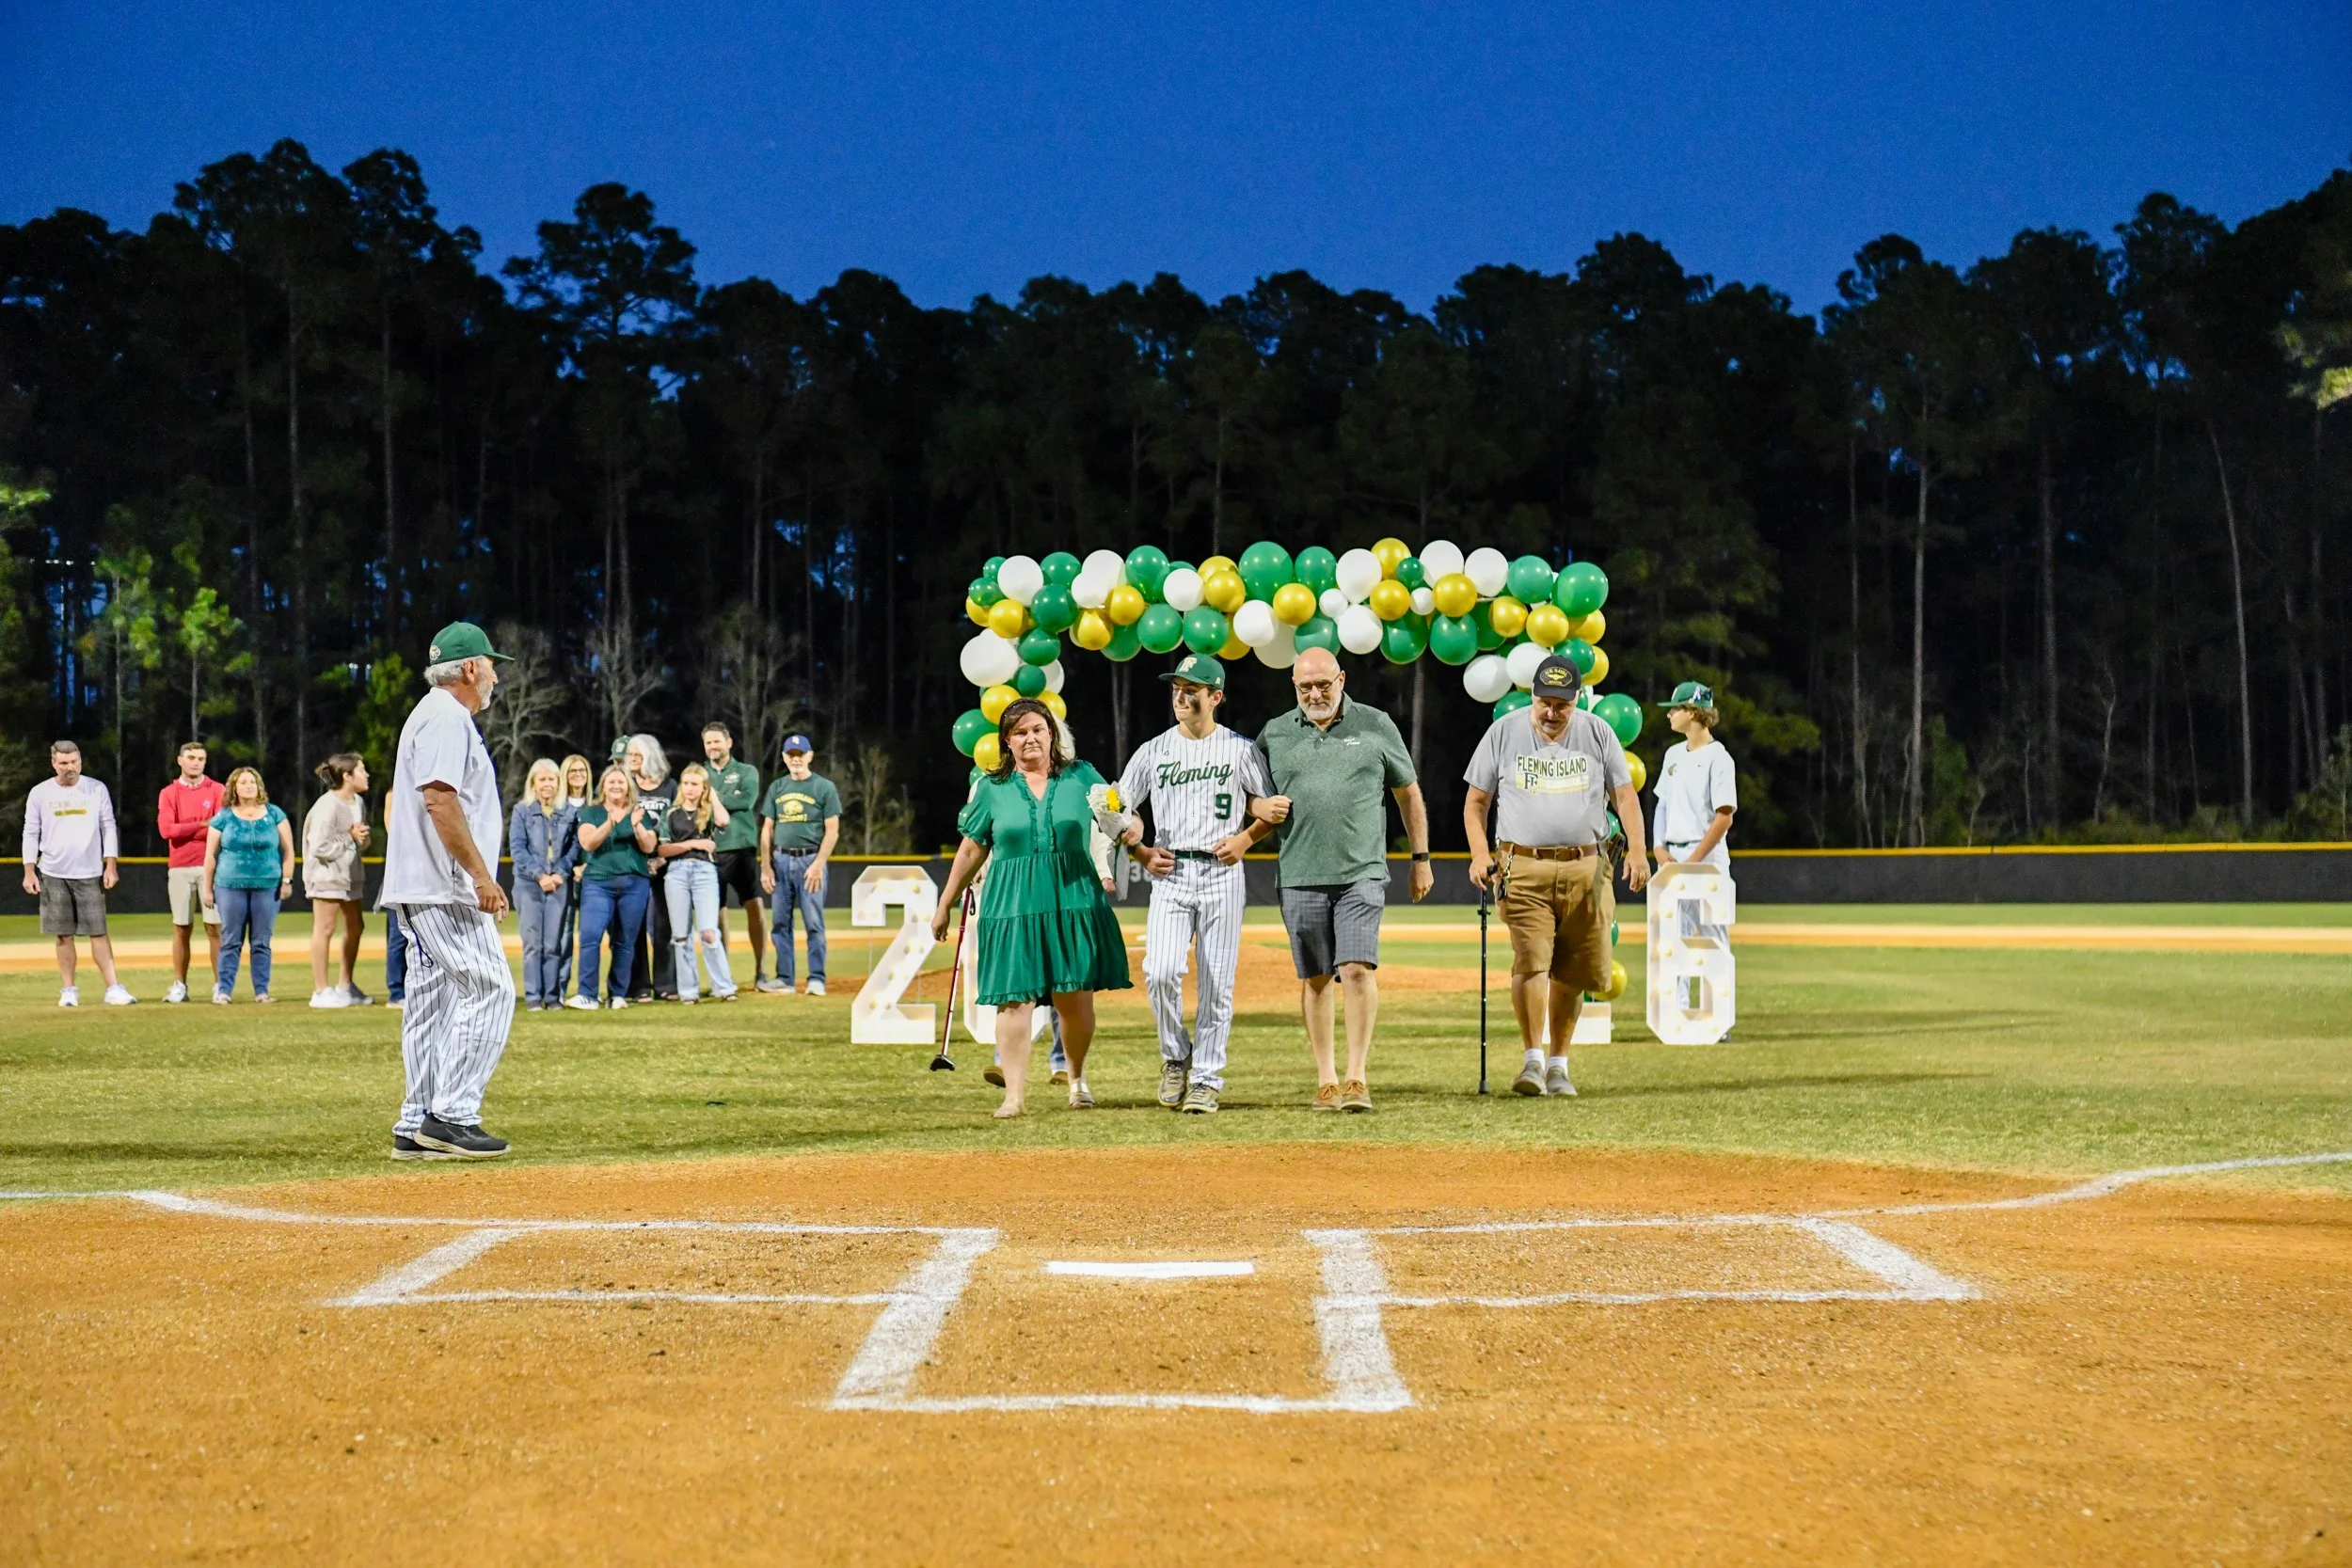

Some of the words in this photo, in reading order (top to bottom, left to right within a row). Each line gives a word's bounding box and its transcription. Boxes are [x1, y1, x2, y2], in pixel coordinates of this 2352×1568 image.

[1179, 657, 1197, 673] F
[1156, 760, 1233, 789] Fleming
[1517, 756, 1554, 777] FLEMING
[1556, 757, 1587, 777] ISLAND
[1215, 793, 1232, 820] 9
[850, 865, 938, 1044] 2
[1646, 862, 1736, 1045] 6
